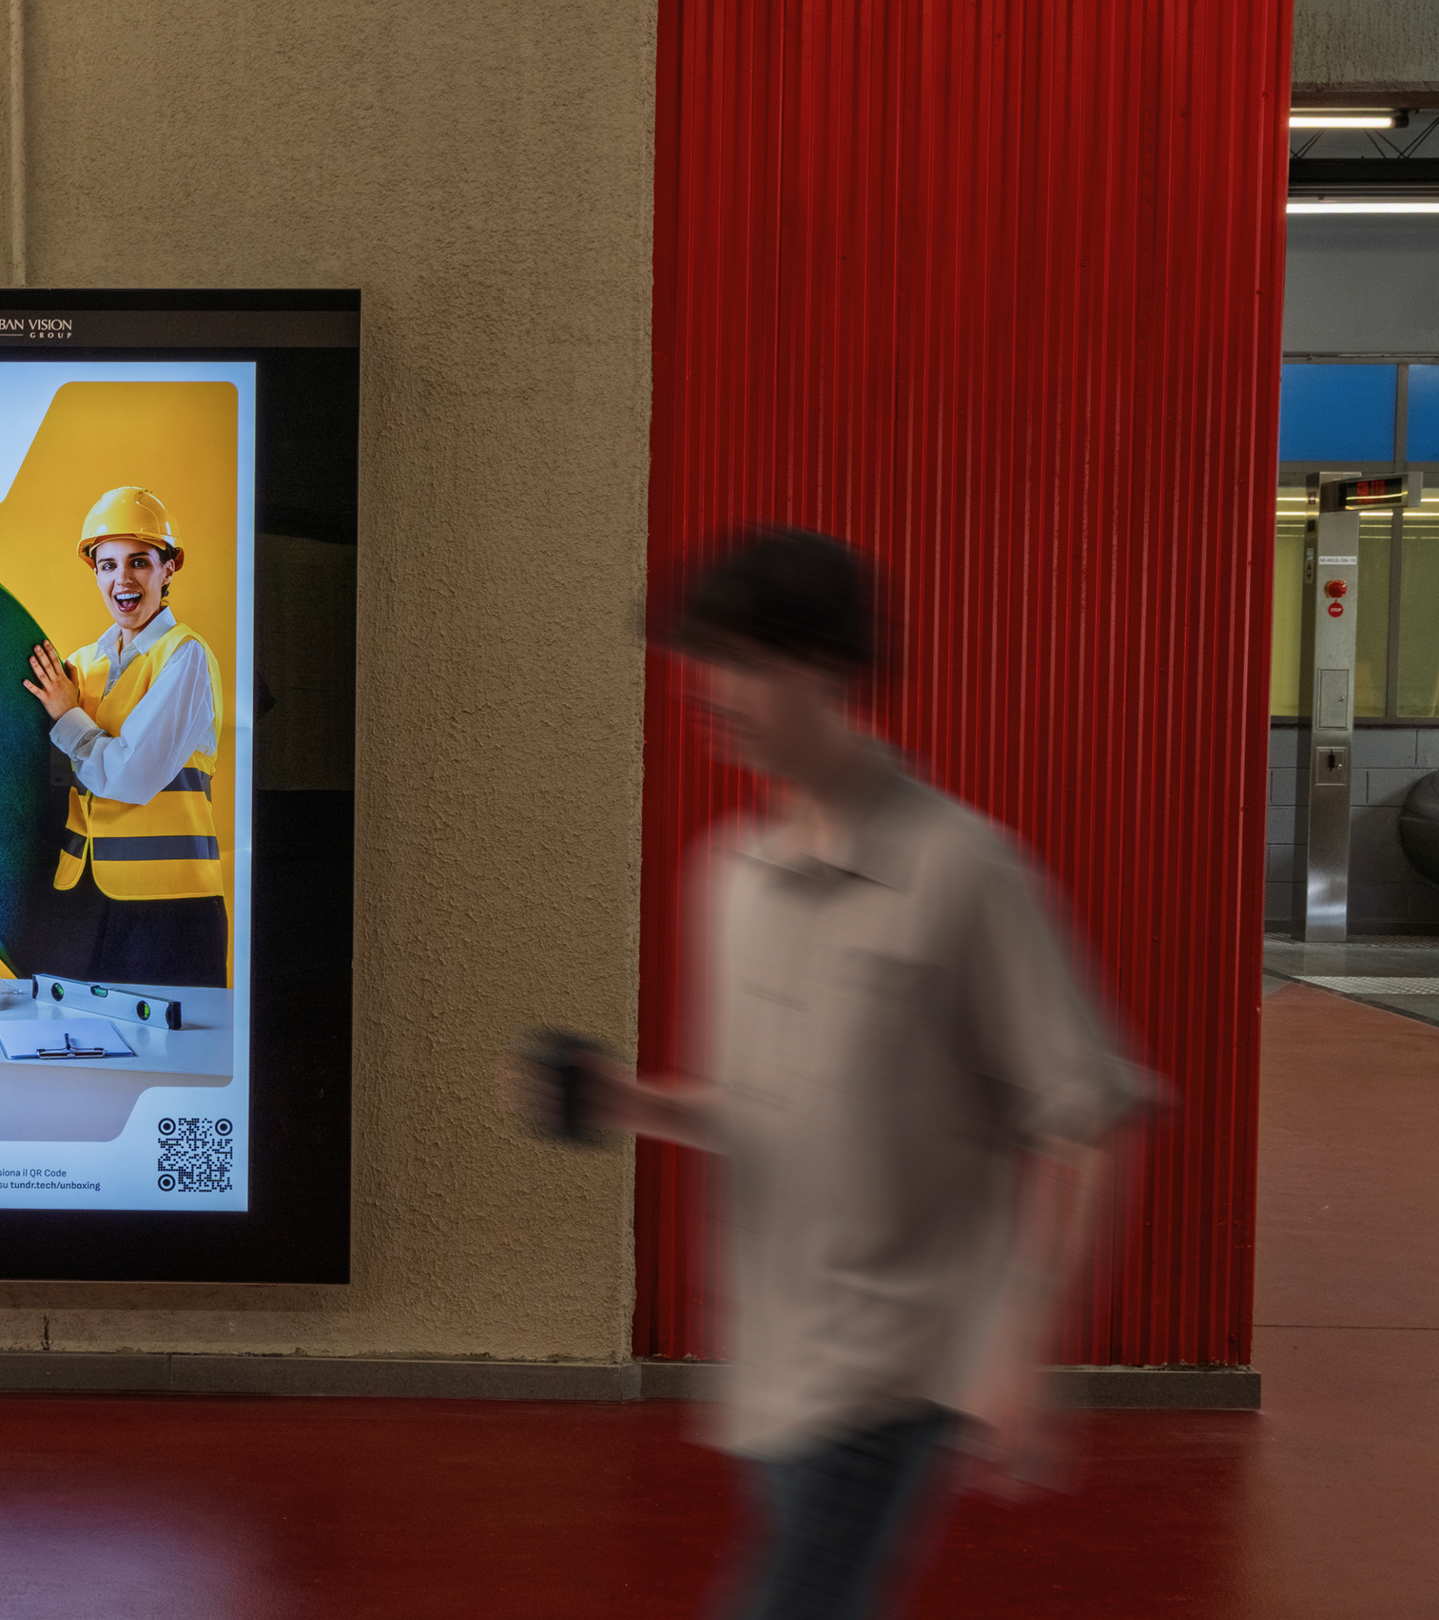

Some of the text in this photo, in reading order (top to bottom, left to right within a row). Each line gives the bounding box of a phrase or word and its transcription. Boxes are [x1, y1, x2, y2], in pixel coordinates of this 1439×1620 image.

[28, 318, 72, 331] VISION
[29, 331, 72, 339] GROUP
[22, 1168, 28, 1177] il
[29, 1168, 43, 1178] QR
[44, 1168, 67, 1177] Code
[10, 1180, 101, 1192] tundr.tech/unboxing
